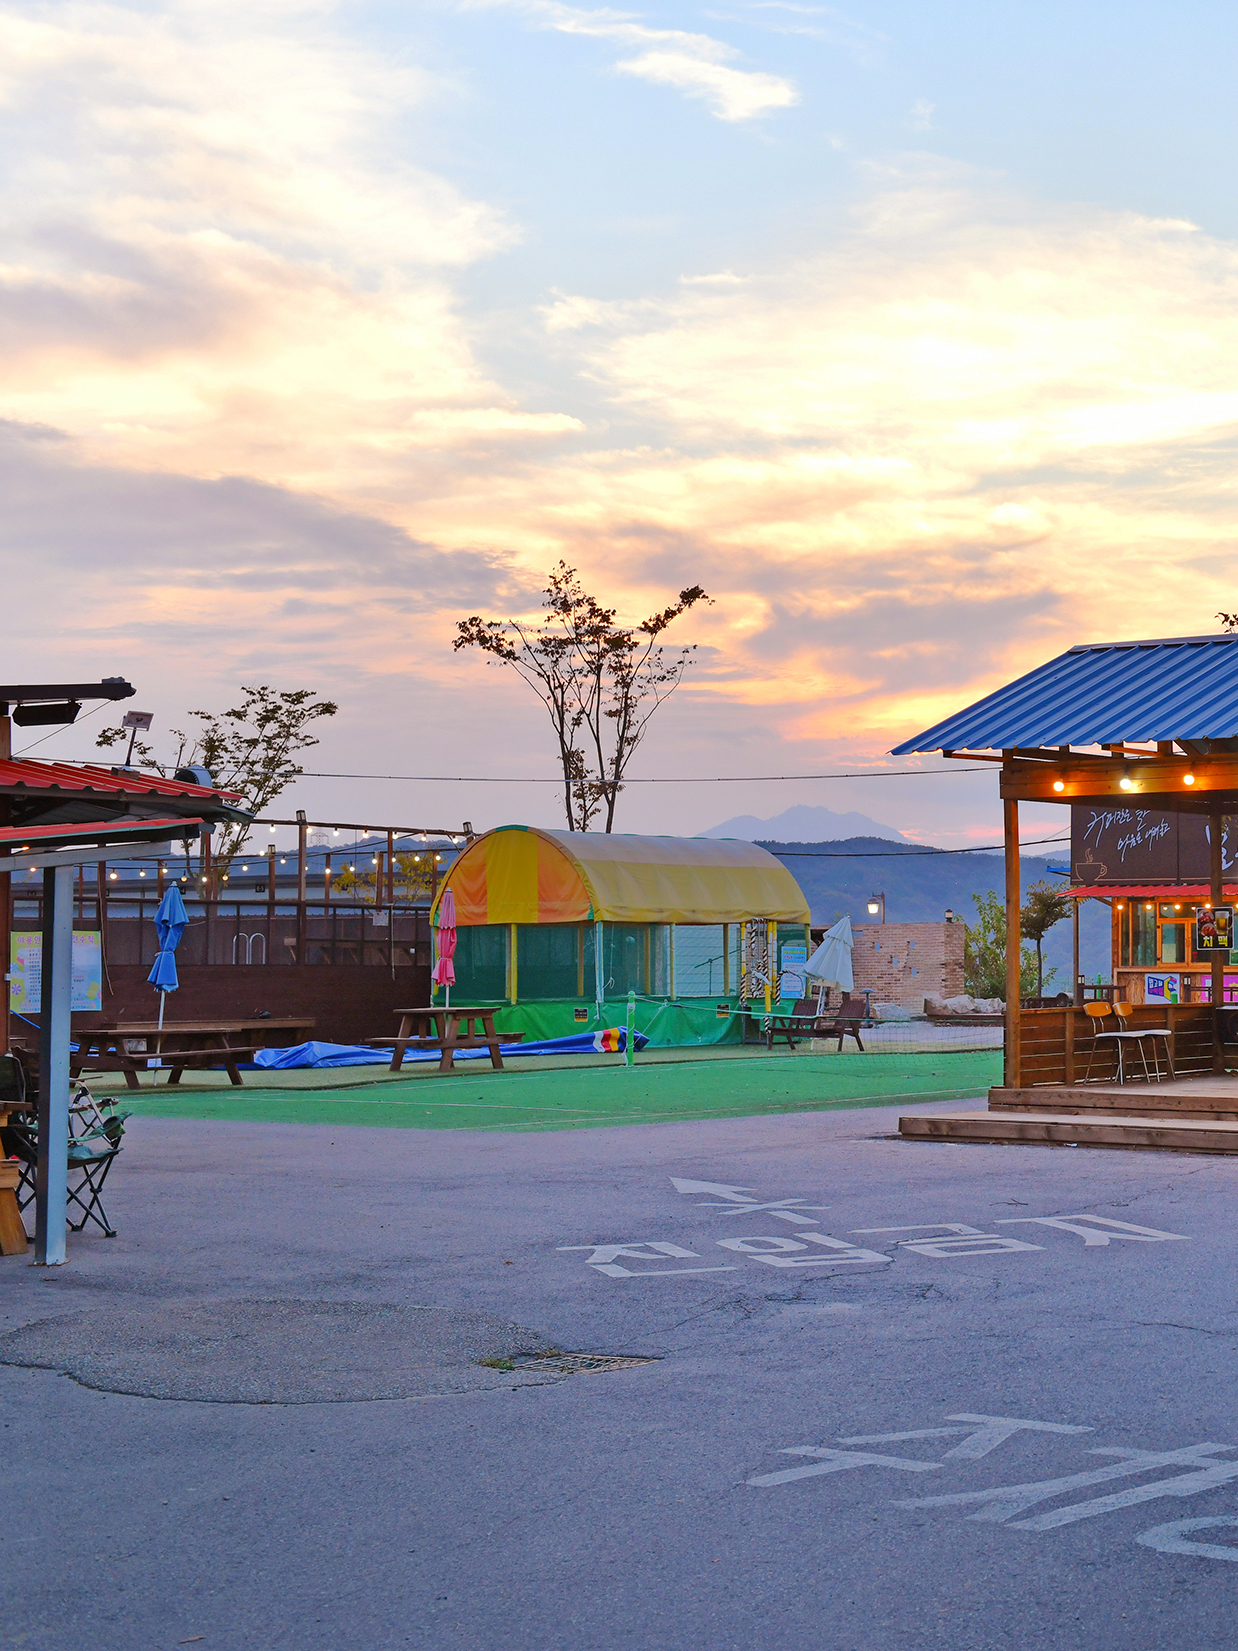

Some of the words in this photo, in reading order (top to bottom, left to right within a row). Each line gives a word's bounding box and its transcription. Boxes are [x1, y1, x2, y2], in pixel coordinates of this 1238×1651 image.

[17, 935, 41, 946] 이용안
[72, 934, 94, 944] 전수칙
[555, 1213, 1194, 1278] 진입금지
